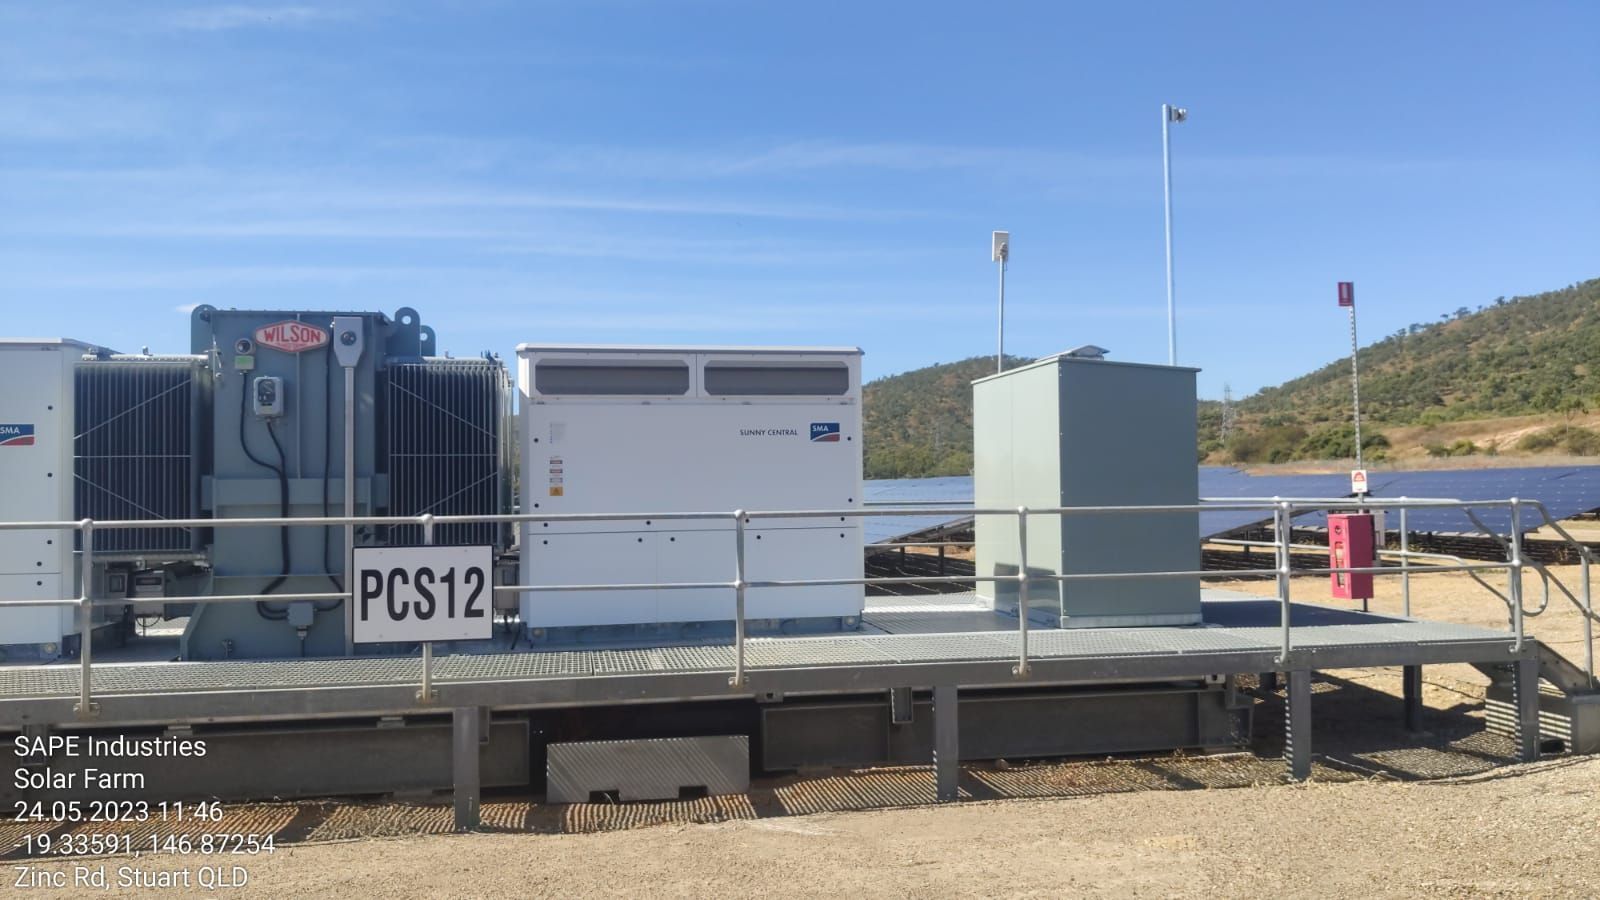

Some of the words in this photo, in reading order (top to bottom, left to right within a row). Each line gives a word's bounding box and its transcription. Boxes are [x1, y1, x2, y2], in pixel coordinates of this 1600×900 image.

[264, 325, 321, 342] WILSON
[0, 426, 20, 434] SMA
[360, 566, 485, 621] PCS12
